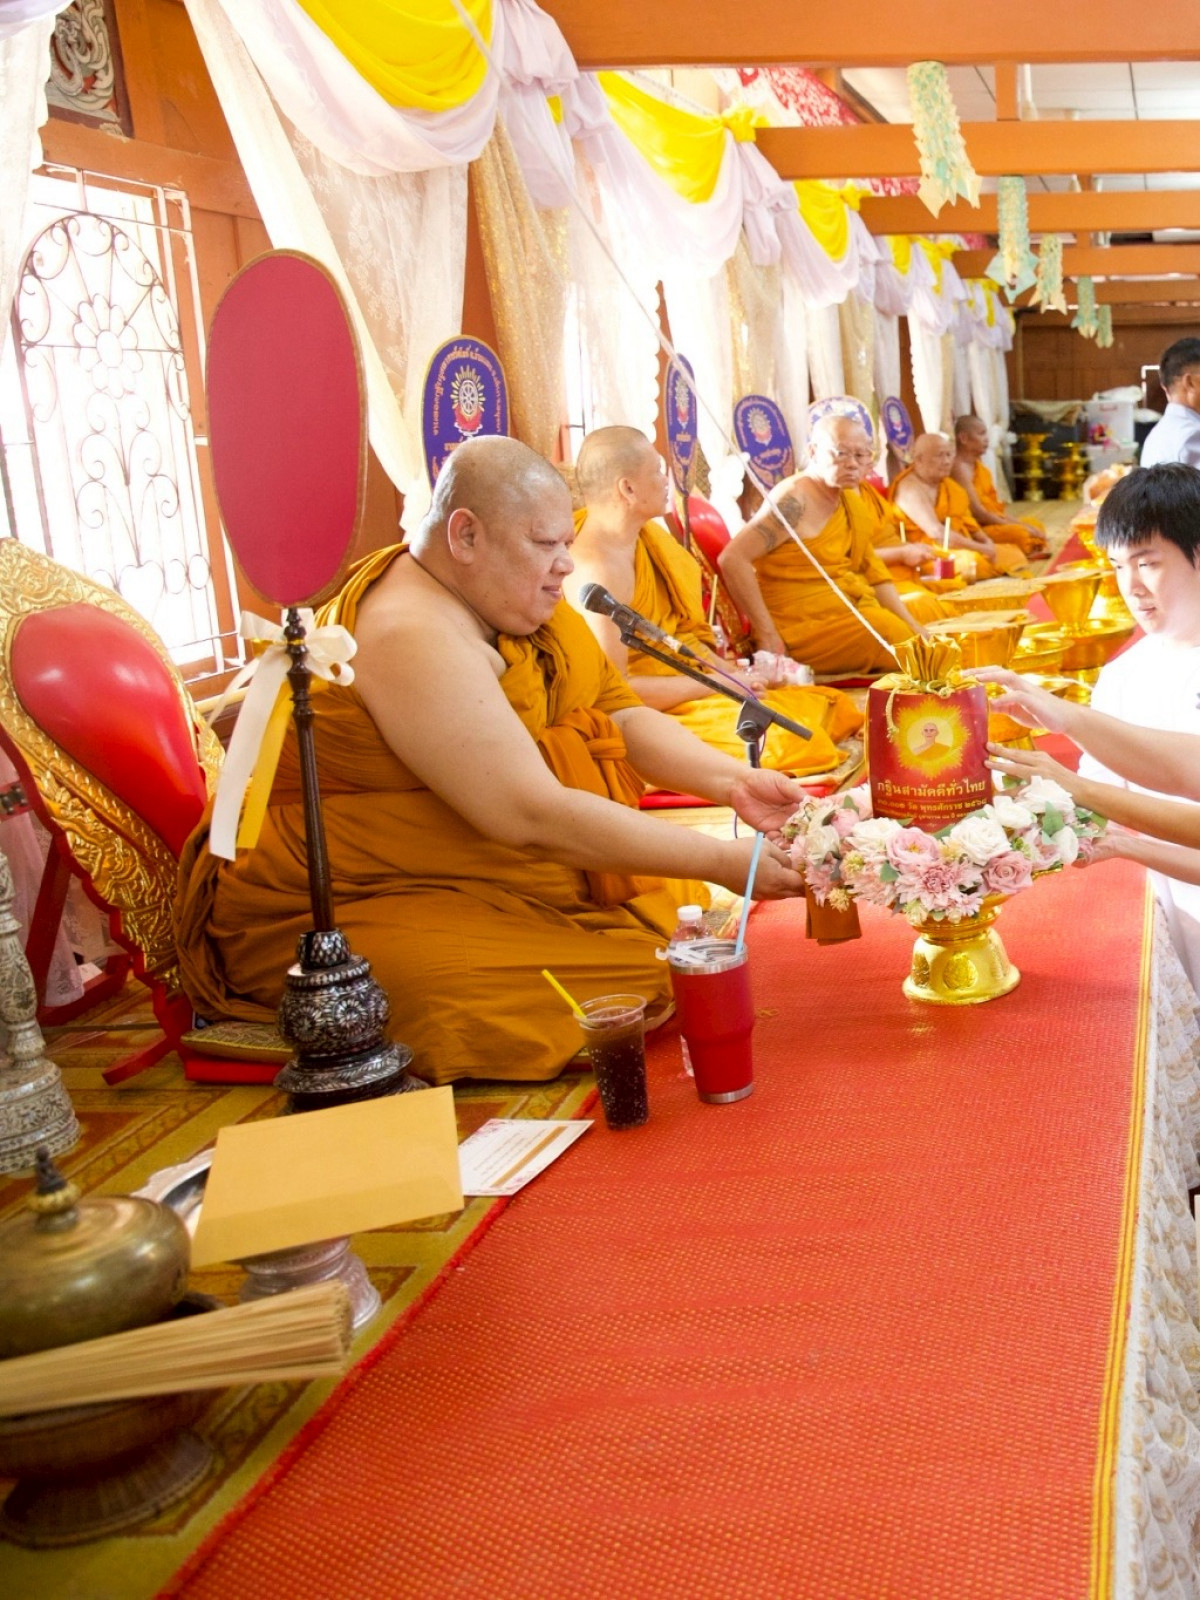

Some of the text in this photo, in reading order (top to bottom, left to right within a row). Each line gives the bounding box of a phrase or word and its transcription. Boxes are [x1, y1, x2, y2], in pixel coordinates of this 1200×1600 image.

[877, 778, 985, 796] กฐินสามัคคีทั่วไทย
